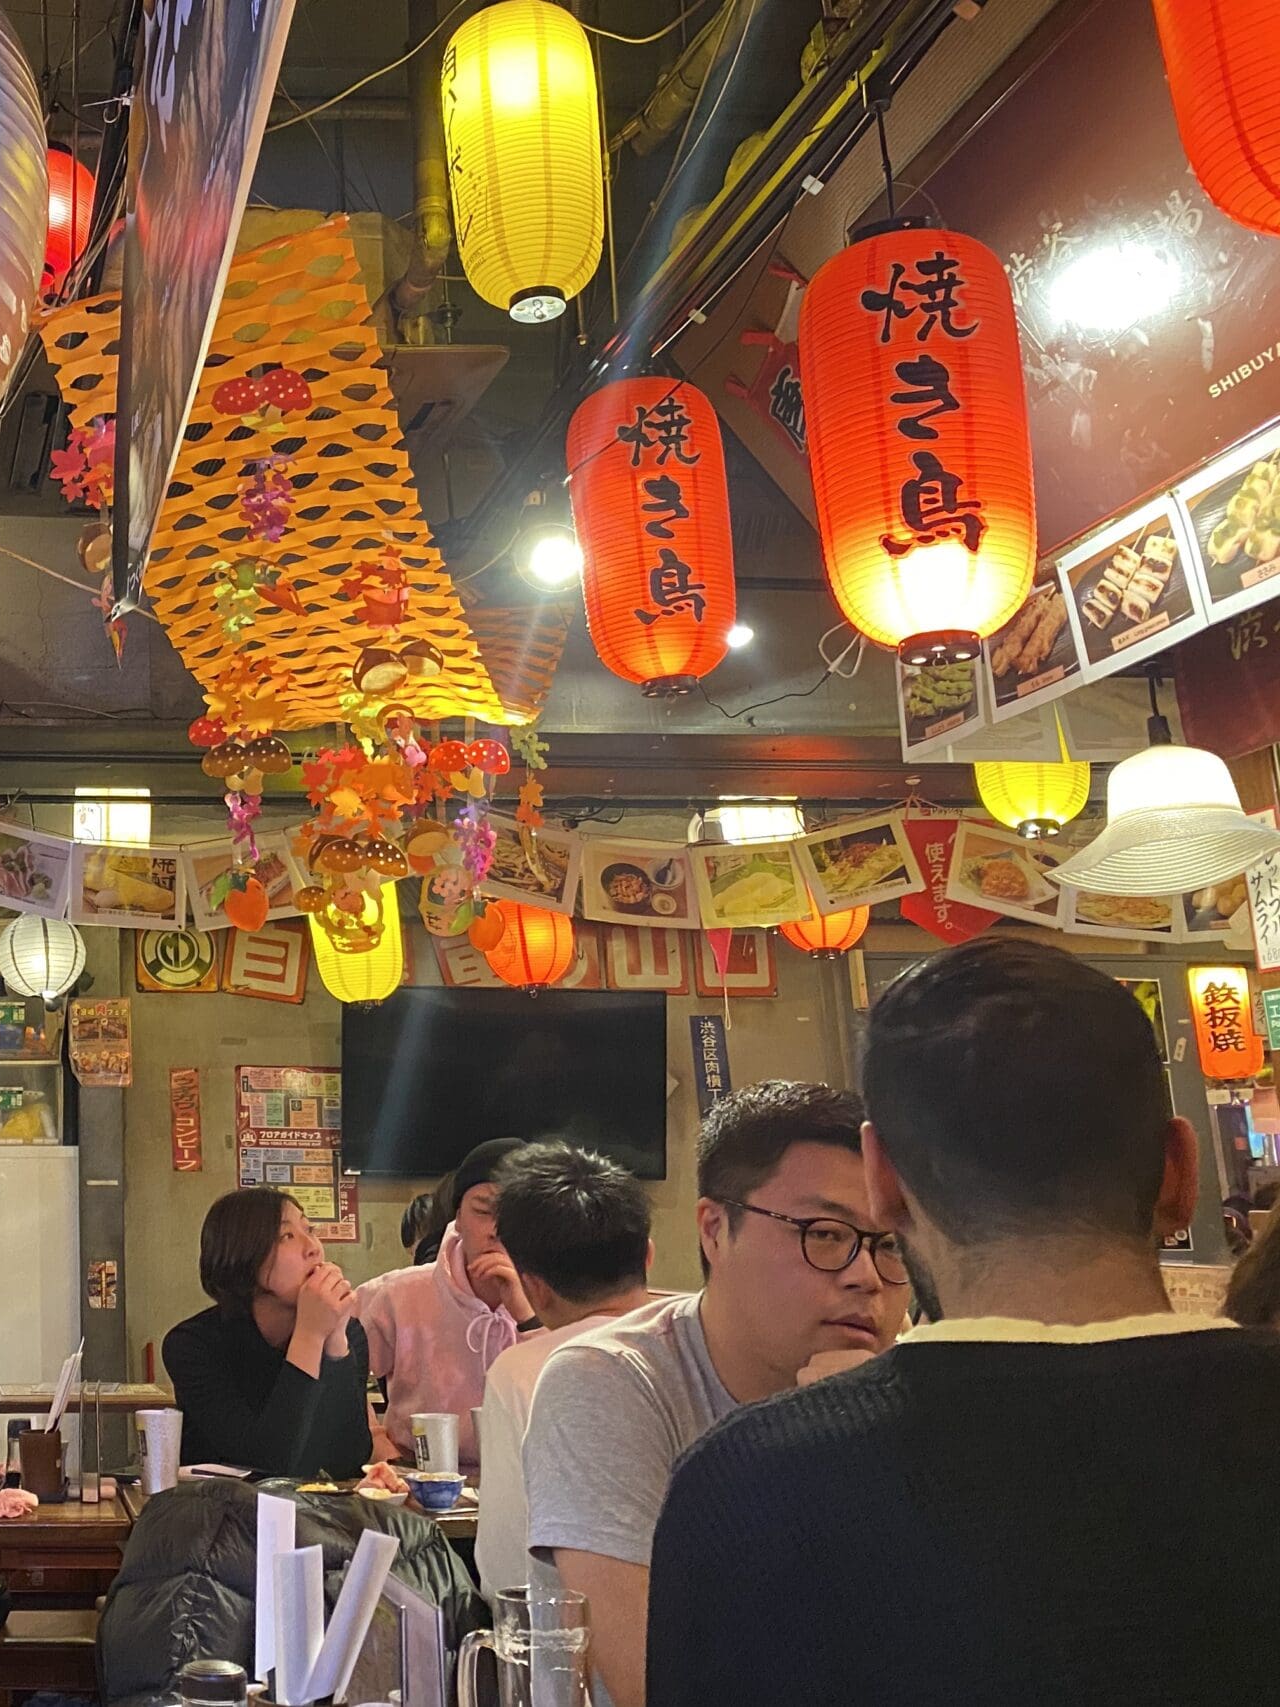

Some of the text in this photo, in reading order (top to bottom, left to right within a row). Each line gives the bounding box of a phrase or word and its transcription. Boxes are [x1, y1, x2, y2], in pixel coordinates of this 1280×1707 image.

[617, 397, 708, 625] 焼き鳥
[860, 251, 987, 557] 焼き鳥
[1201, 981, 1247, 1052] 鉄板焼
